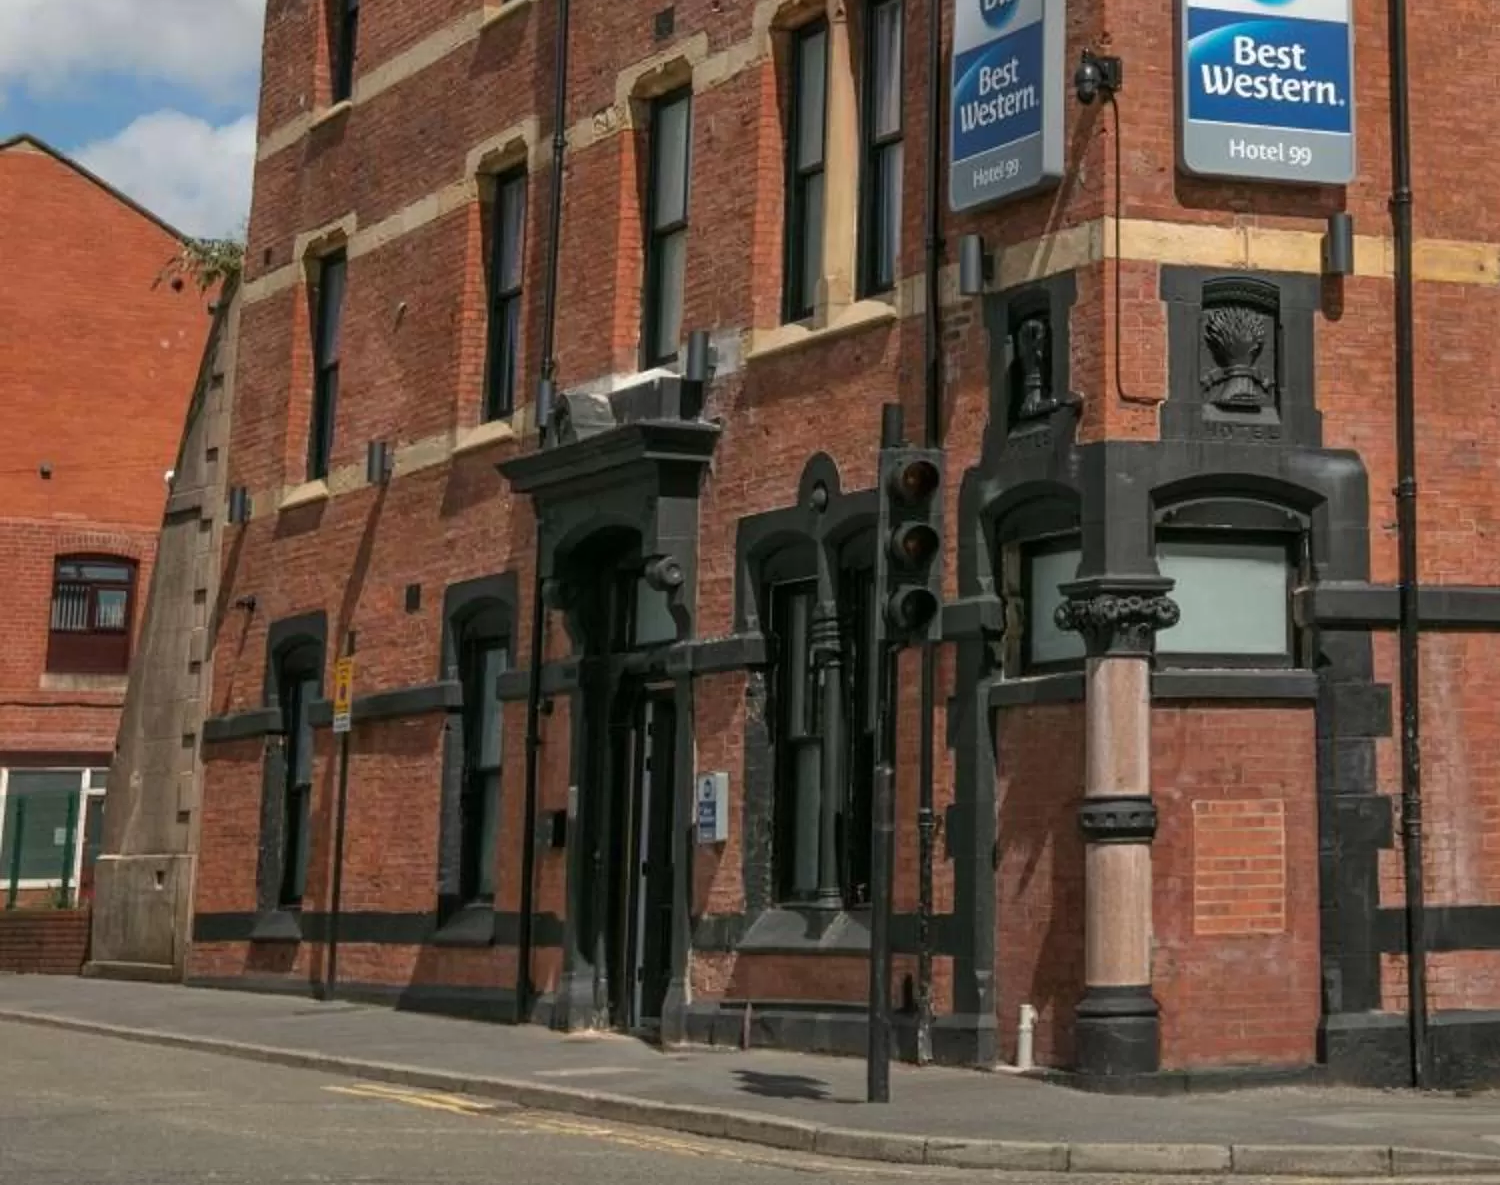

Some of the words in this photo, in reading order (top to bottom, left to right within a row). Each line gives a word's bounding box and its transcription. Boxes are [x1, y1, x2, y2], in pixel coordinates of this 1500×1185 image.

[1233, 34, 1308, 72] Best
[978, 58, 1020, 97] Best
[1228, 138, 1285, 162] Hotel
[1287, 145, 1313, 166] 99
[972, 162, 1005, 189] Hotel
[1004, 157, 1021, 181] 99
